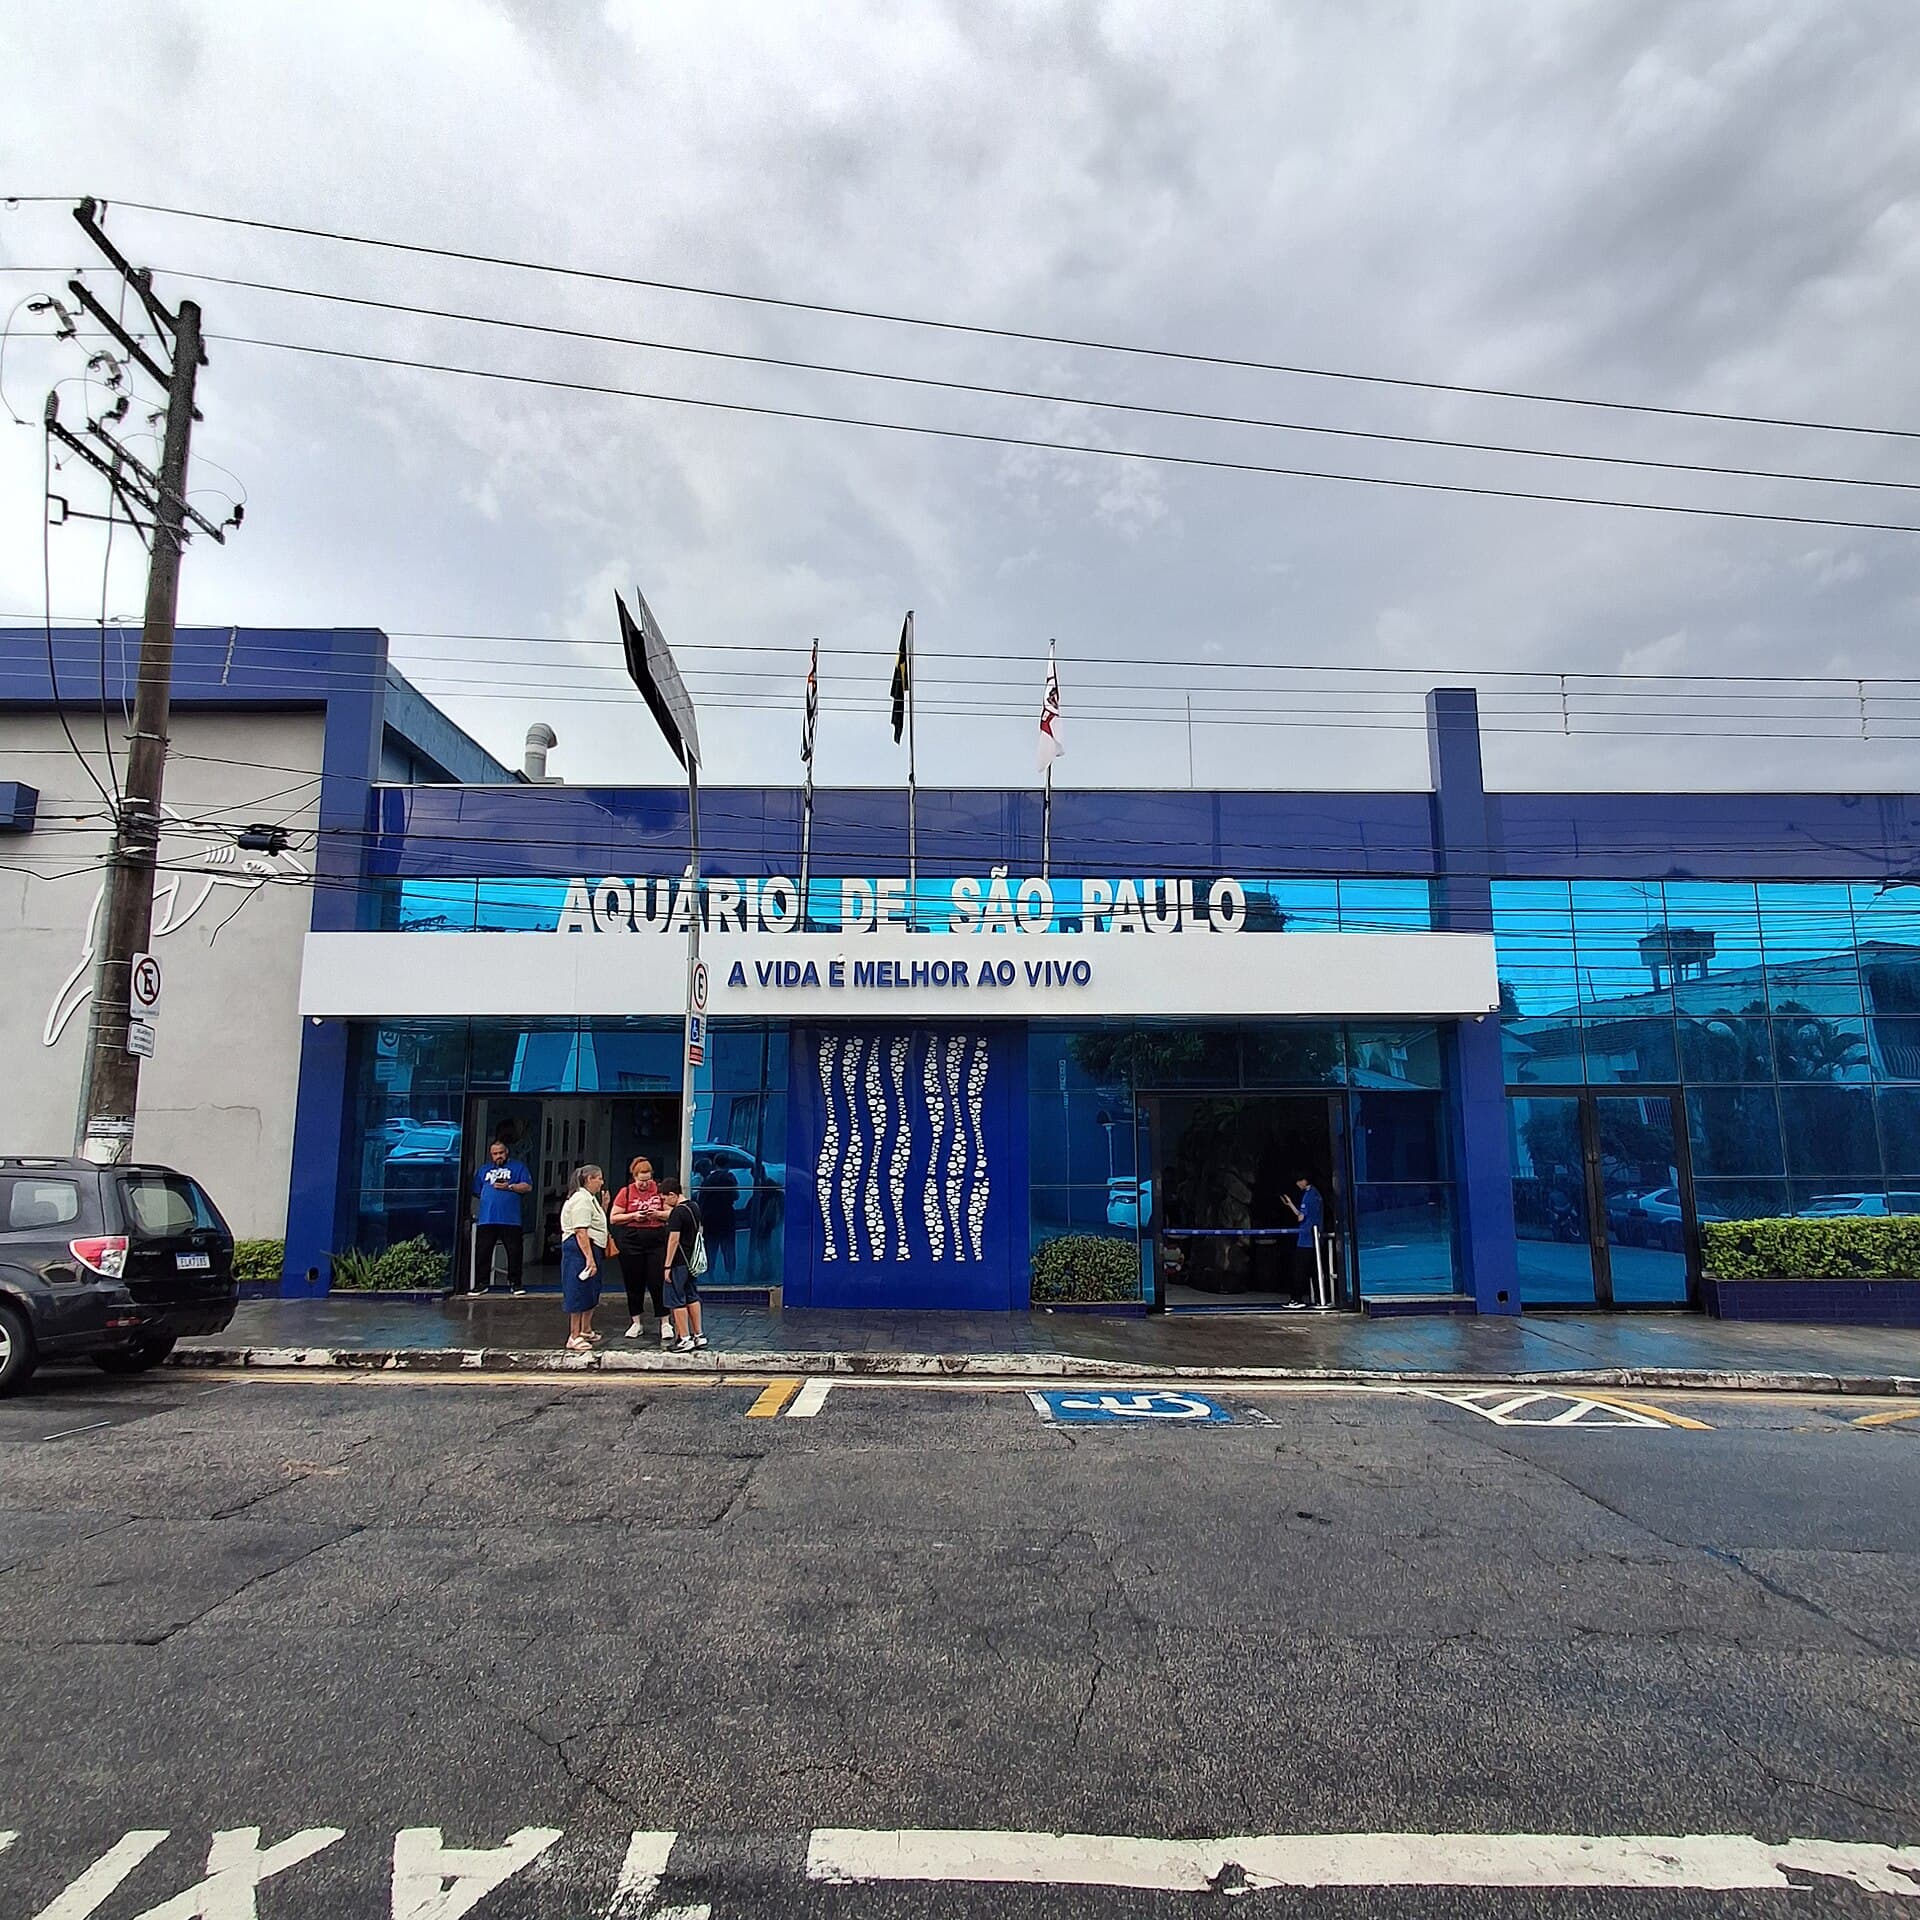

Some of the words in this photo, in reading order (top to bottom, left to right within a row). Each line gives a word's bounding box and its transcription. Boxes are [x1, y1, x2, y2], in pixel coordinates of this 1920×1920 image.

[556, 865, 799, 934] AQUÁRIO
[840, 876, 908, 934] DE
[949, 865, 1054, 934] SÃO
[1081, 877, 1248, 934] PAULO
[727, 961, 748, 987] A
[754, 961, 822, 987] VIDA
[853, 961, 970, 987] MELHOR
[976, 960, 1016, 987] AO
[1023, 960, 1092, 987] VIVO
